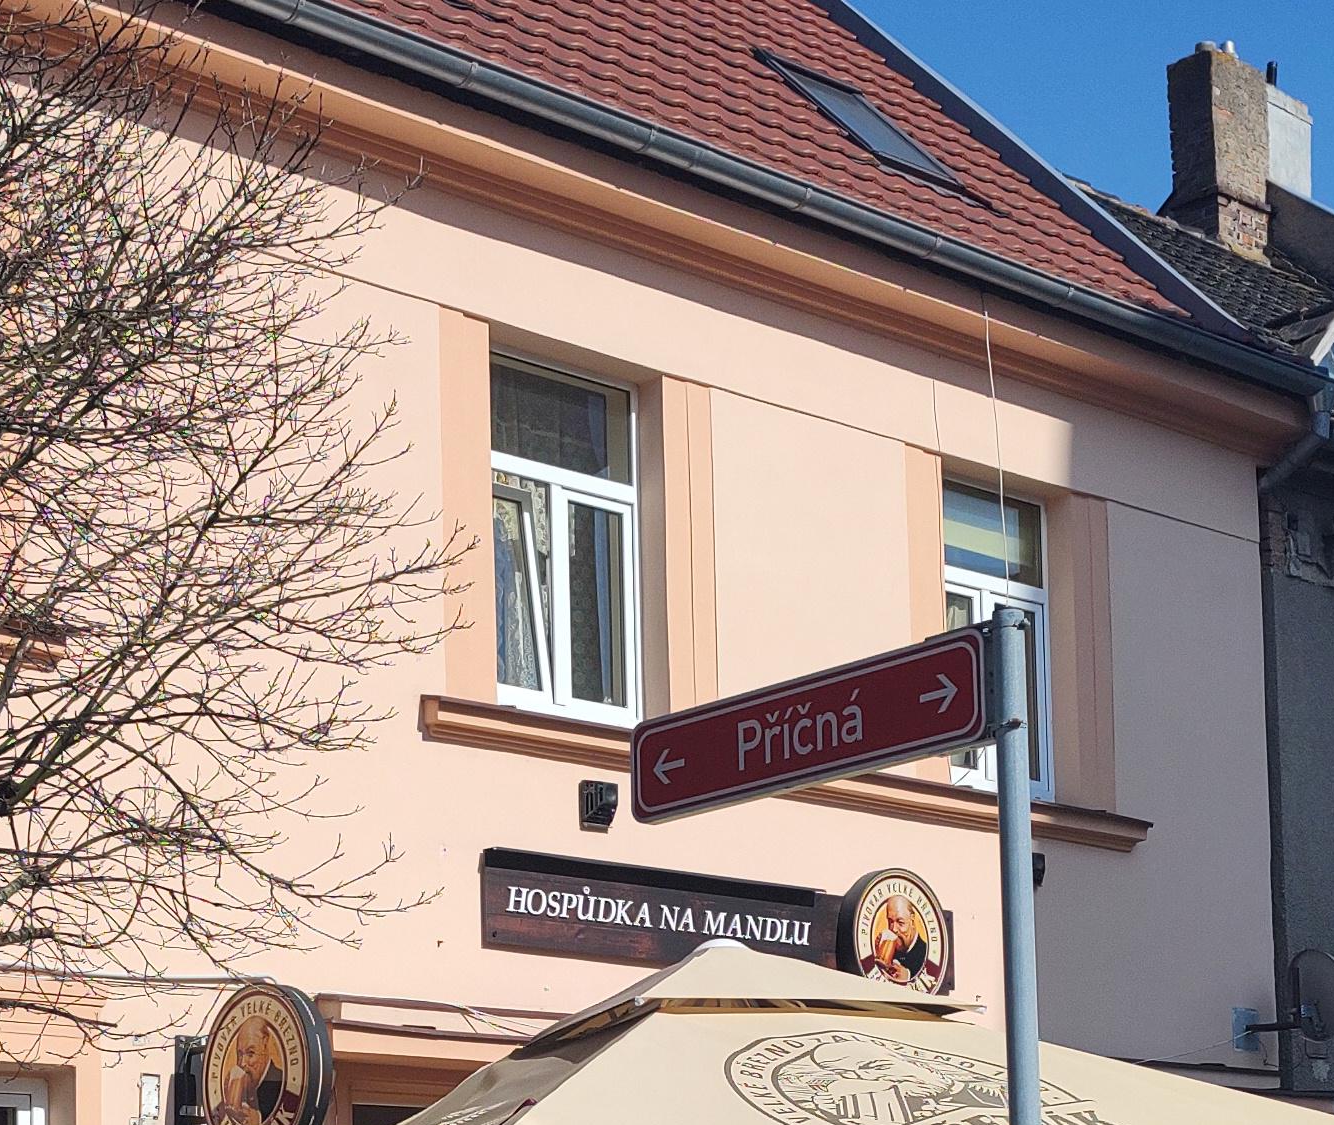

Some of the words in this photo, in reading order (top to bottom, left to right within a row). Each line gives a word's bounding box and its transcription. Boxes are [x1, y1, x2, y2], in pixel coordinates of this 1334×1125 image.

[737, 688, 863, 771] Příčná
[506, 886, 652, 928] HOSPŮDKA
[659, 905, 696, 933] NA
[703, 909, 812, 946] MANDLU
[240, 998, 273, 1019] VELKÉ
[273, 1011, 300, 1067] BŘEZNO
[736, 1039, 805, 1079] BŘEZNO
[737, 1081, 811, 1124] VELKÉ
